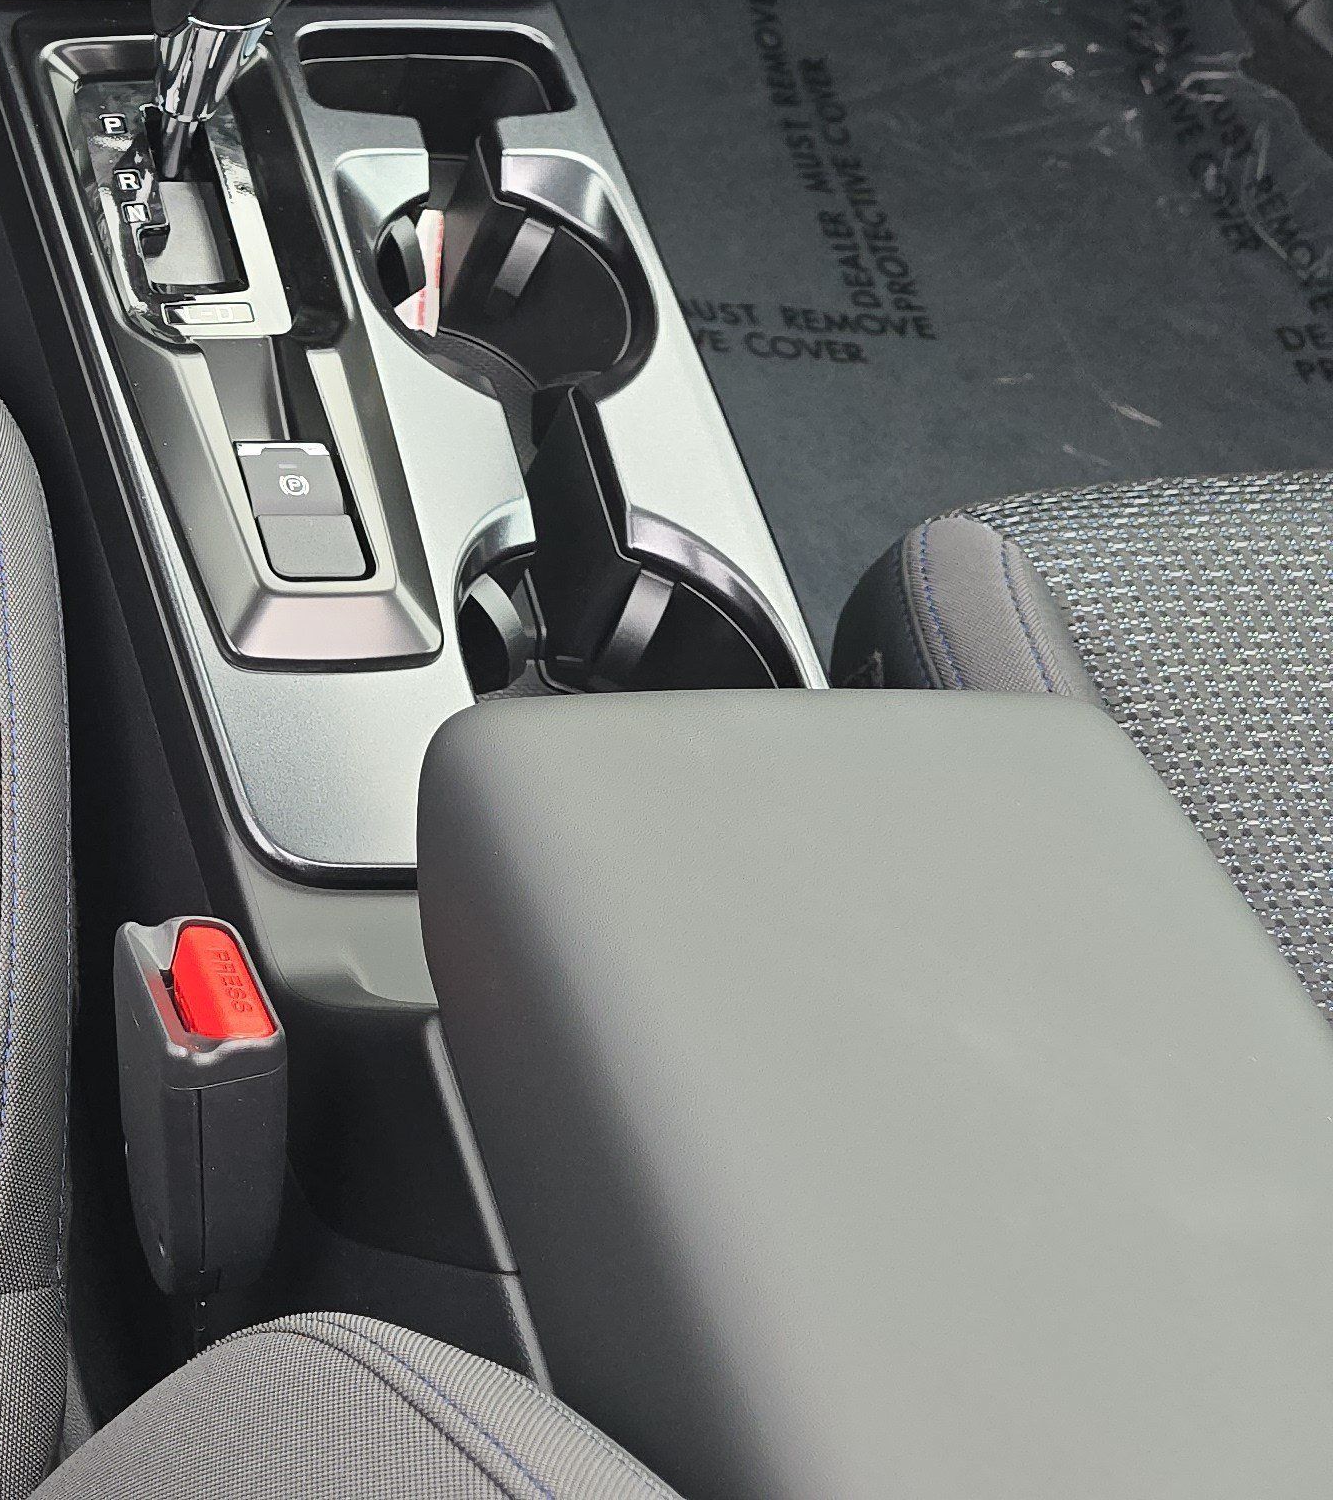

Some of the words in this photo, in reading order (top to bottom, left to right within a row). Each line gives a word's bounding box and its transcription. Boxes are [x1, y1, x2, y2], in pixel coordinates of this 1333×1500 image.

[103, 117, 122, 134] P
[118, 173, 139, 190] R
[127, 205, 147, 222] N
[818, 210, 883, 310] DEALER
[744, 331, 870, 366] COVER
[213, 948, 253, 1014] PRESS
